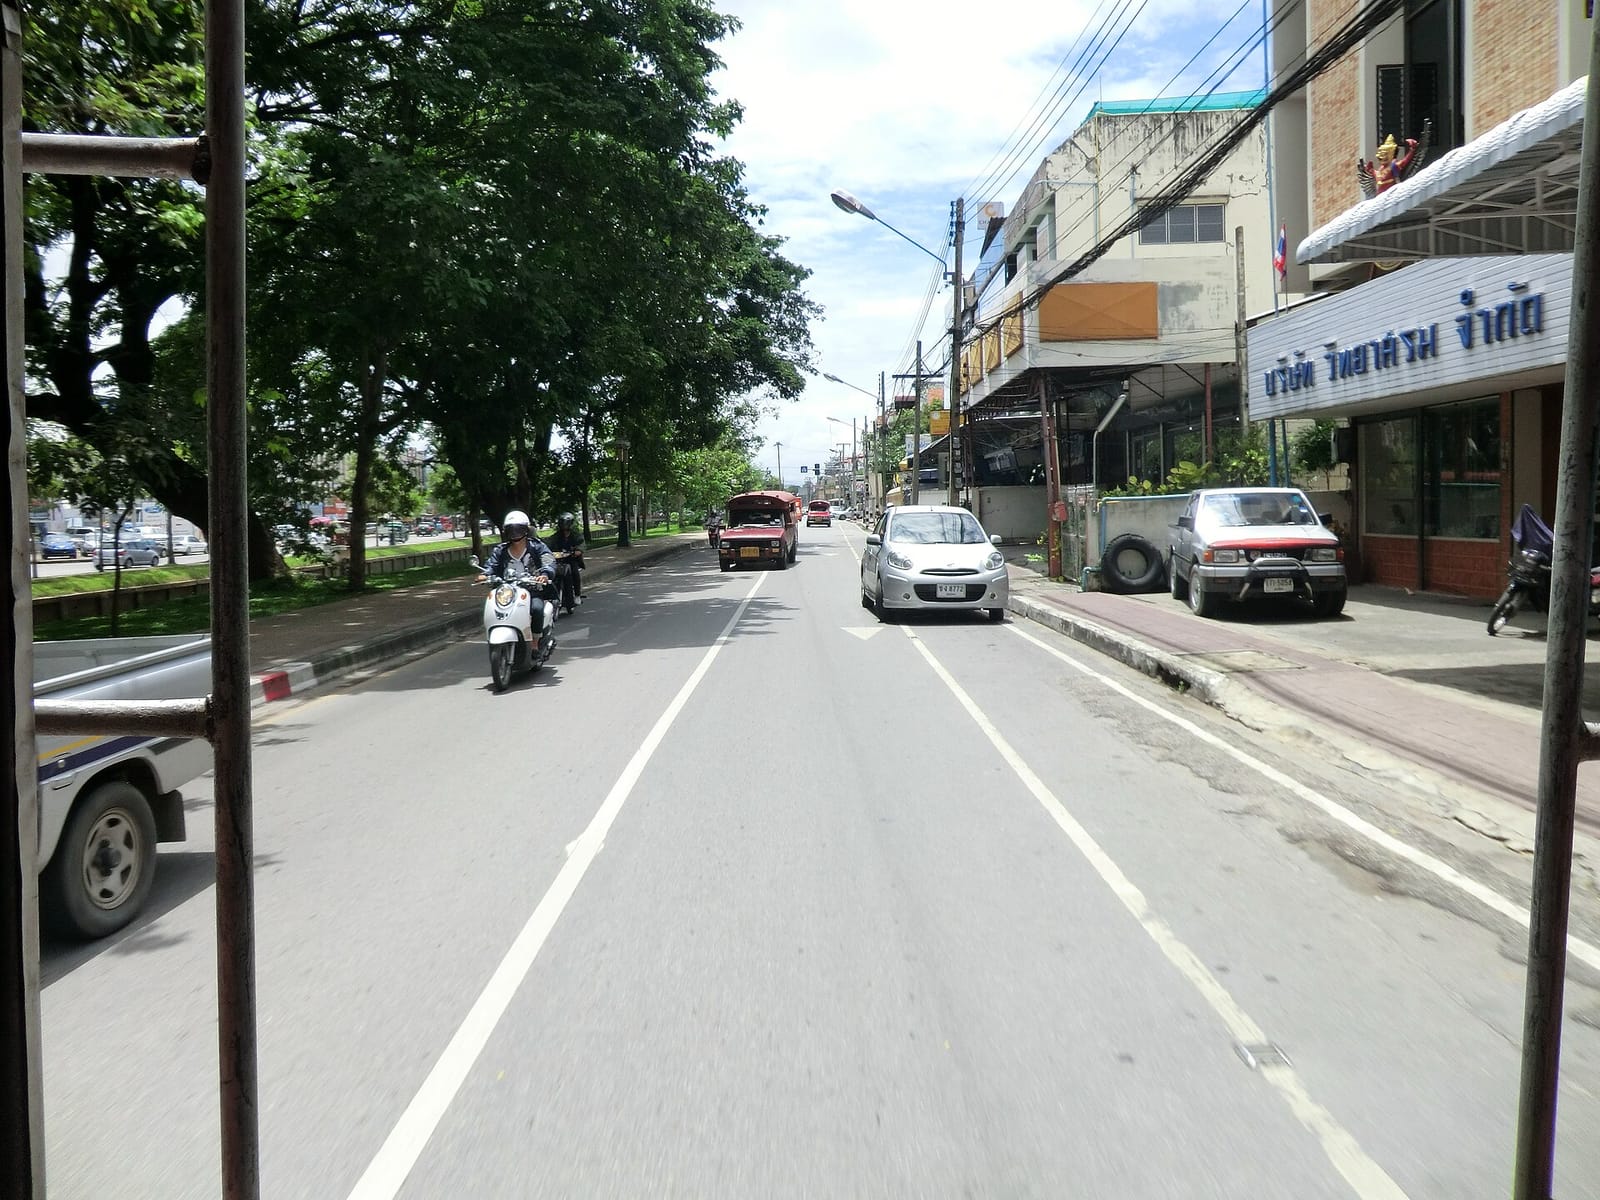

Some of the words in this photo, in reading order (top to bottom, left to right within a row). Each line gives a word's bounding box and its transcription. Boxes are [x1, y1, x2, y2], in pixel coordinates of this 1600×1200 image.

[1264, 349, 1315, 396] บริษัท
[1455, 280, 1545, 350] จำกัด
